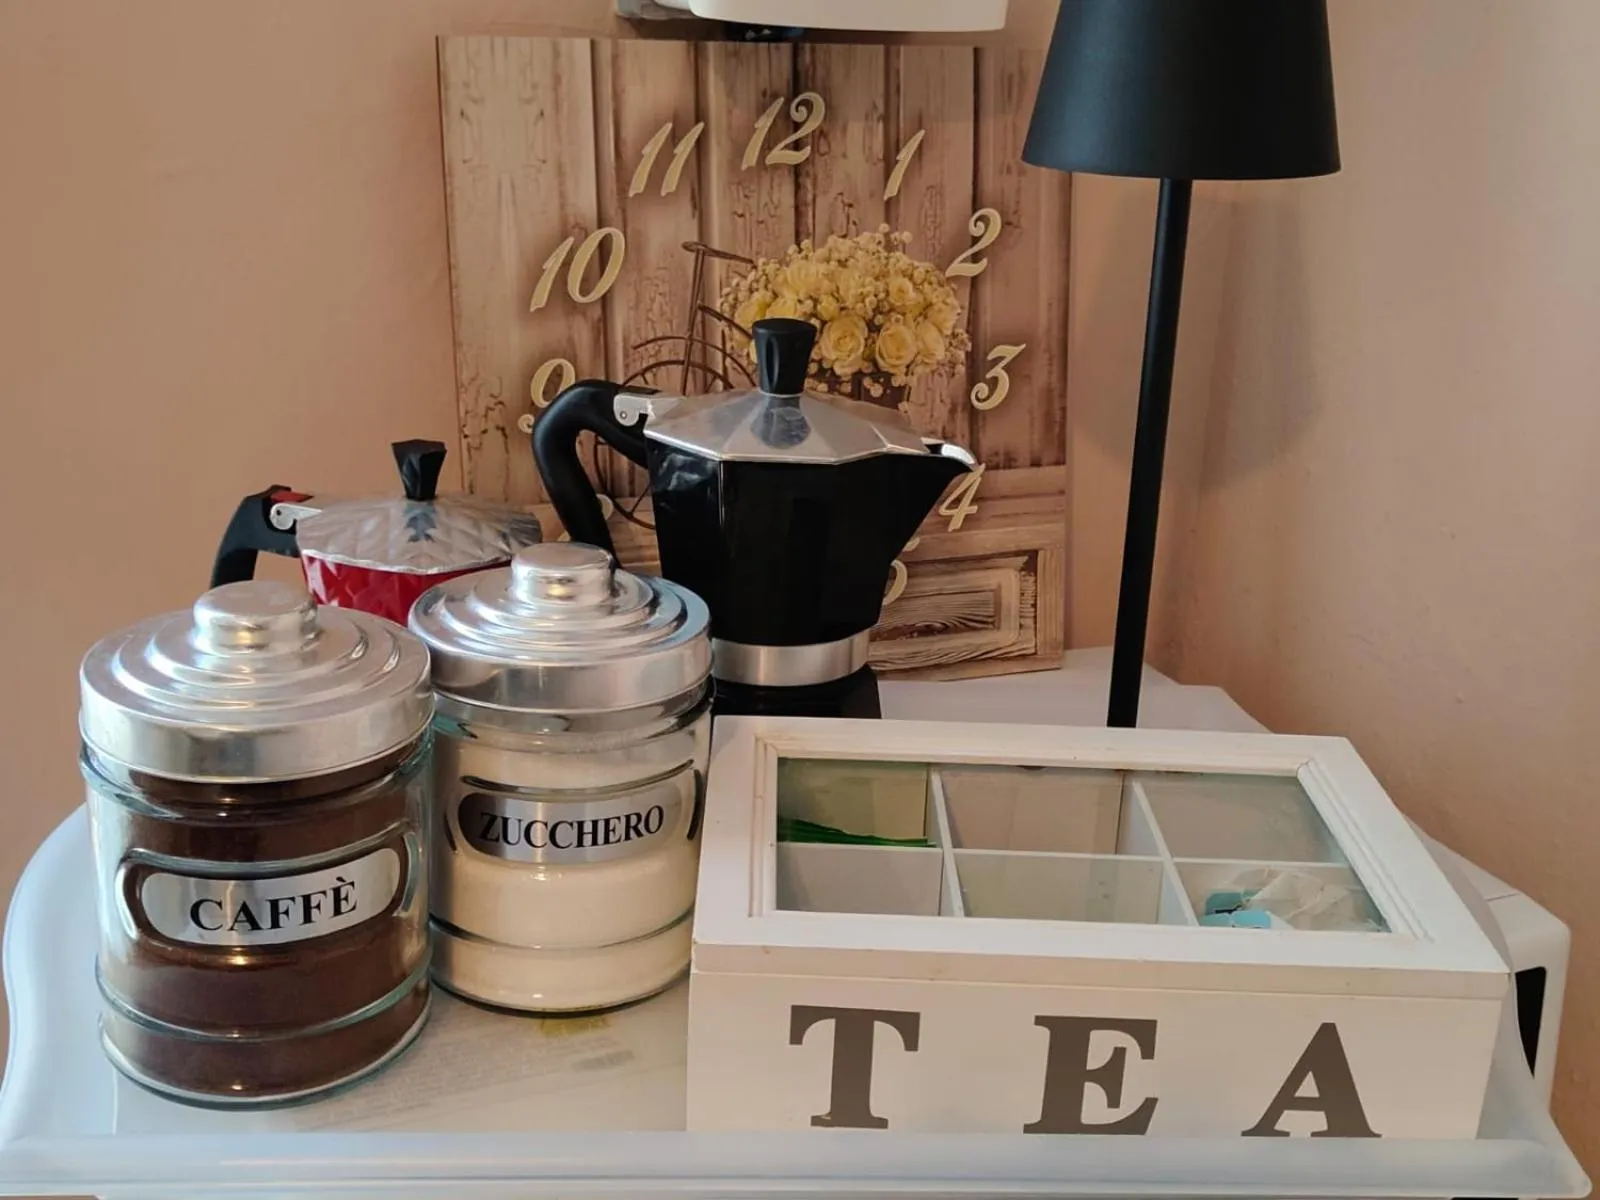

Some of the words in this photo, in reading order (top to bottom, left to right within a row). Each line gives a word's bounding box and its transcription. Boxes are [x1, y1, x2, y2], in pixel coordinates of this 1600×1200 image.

[628, 122, 705, 197] 11
[741, 92, 826, 169] 12
[884, 129, 926, 200] 1
[530, 227, 626, 312] 10
[945, 208, 1002, 278] 2
[970, 344, 1026, 410] 3
[938, 463, 986, 532] 4
[482, 805, 664, 850] ZUCCHERO
[189, 877, 357, 931] CAFFÈ
[789, 1005, 1382, 1138] TEA
